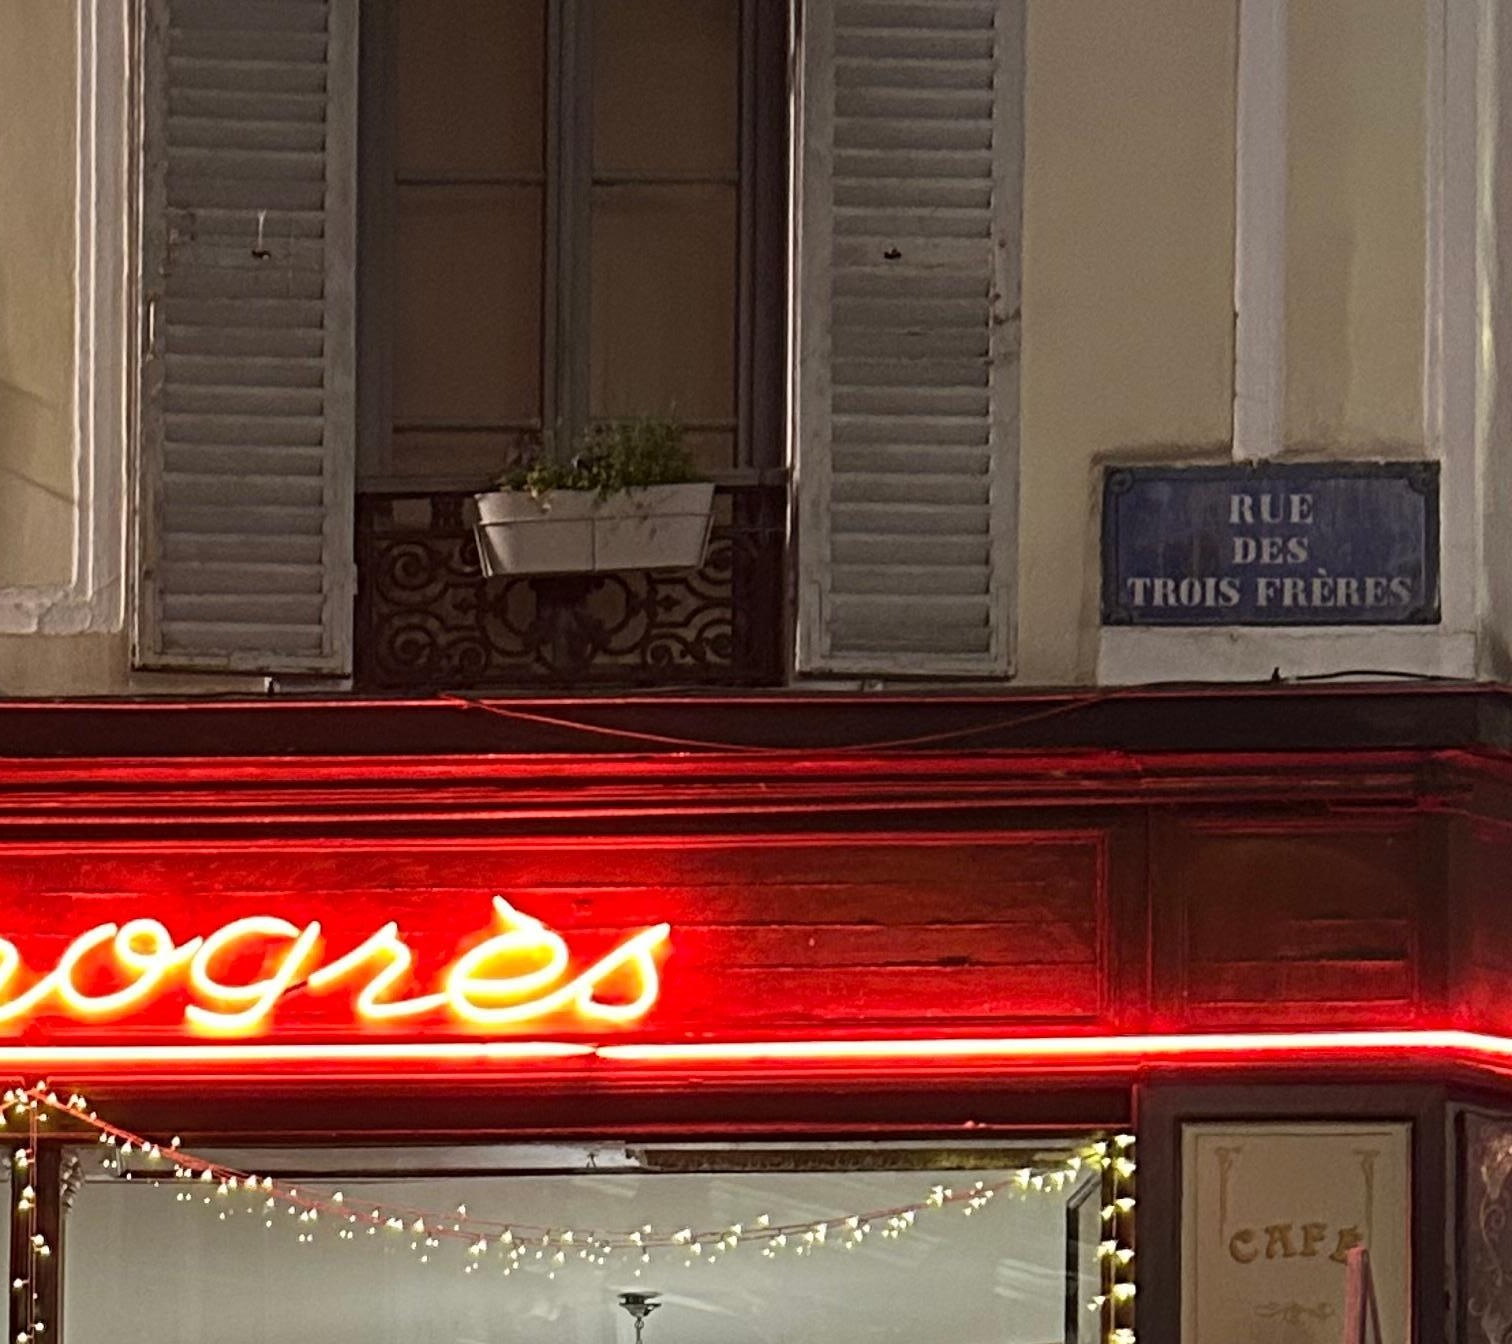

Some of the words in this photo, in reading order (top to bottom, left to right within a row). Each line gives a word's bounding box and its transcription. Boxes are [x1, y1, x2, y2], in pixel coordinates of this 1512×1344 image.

[1228, 493, 1314, 525] RUE
[1232, 536, 1309, 565] DES
[1126, 576, 1240, 608] TROIS
[1256, 568, 1414, 609] FRÈRES
